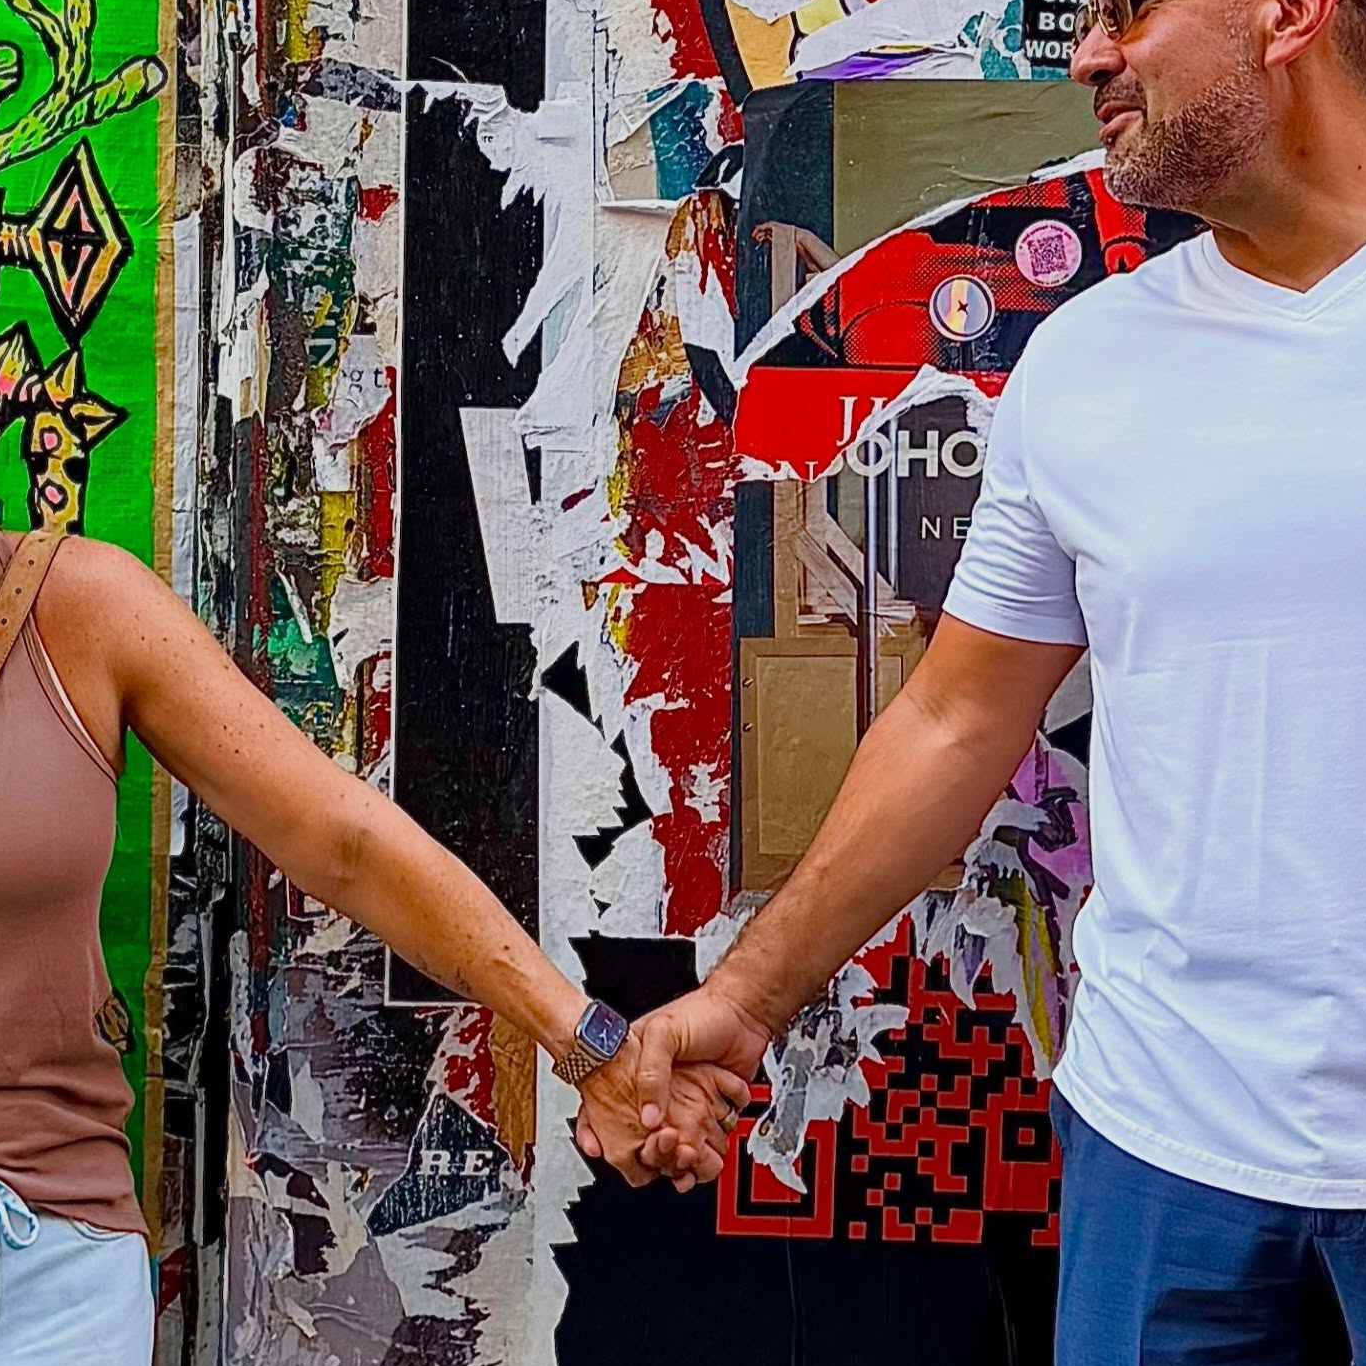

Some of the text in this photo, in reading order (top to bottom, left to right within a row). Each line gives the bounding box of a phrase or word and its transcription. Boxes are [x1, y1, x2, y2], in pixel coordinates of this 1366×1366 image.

[1038, 11, 1075, 32] BO
[1024, 41, 1075, 60] WOR
[827, 430, 987, 478] OHO
[921, 517, 971, 539] NE
